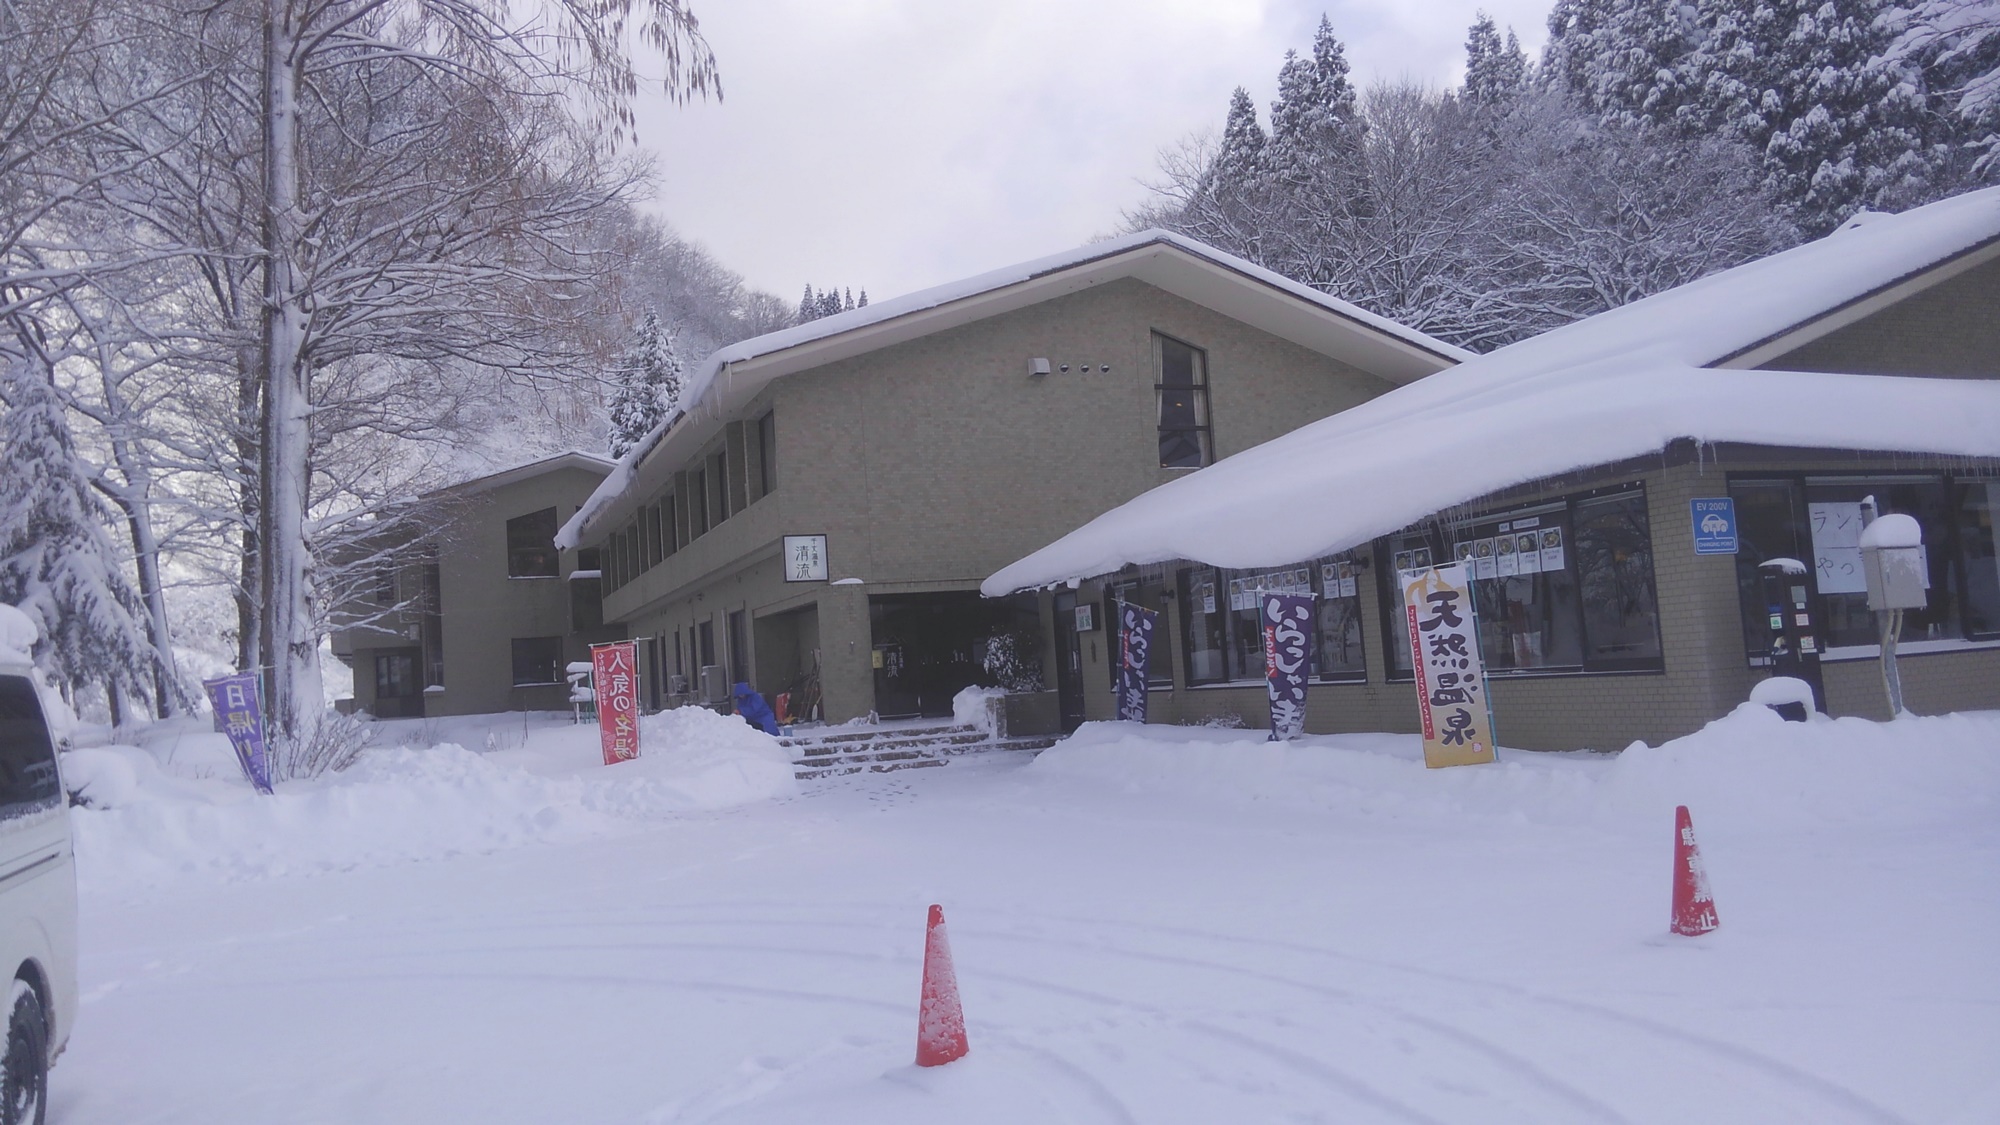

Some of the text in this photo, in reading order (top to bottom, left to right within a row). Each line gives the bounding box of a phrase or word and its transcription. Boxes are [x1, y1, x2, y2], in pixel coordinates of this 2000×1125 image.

[1697, 502, 1728, 511] EV 200V
[1814, 511, 1862, 533] ラン
[795, 545, 811, 579] 清流
